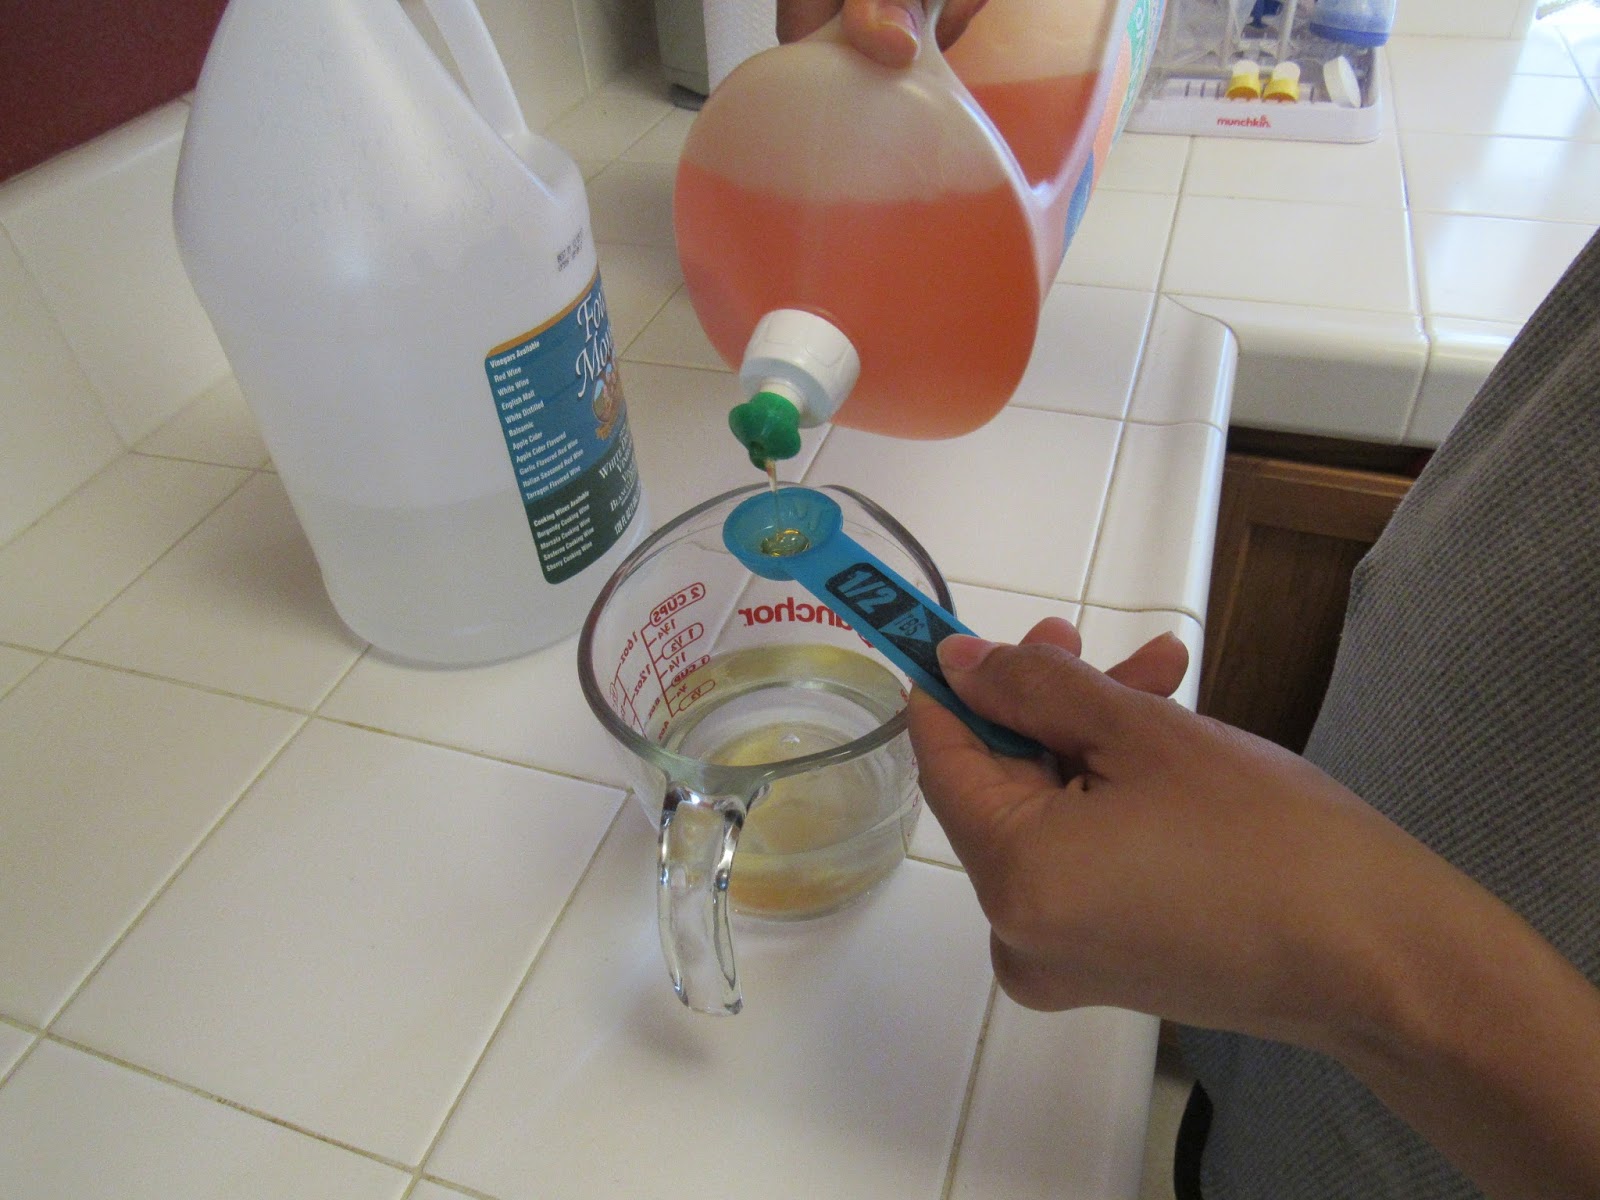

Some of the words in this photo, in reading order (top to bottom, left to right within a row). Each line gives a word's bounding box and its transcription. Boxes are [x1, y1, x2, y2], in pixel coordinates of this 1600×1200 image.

[489, 352, 516, 369] Vinegars
[516, 340, 541, 359] Available
[493, 371, 507, 383] Red
[506, 366, 522, 378] Wine
[497, 384, 515, 397] White
[515, 378, 530, 389] Wine
[501, 397, 523, 411] English
[504, 412, 522, 424] White
[522, 400, 545, 417] Distilled
[508, 421, 534, 437] Balsamic
[512, 438, 529, 451] Apple
[528, 431, 543, 443] Cider
[516, 451, 532, 463] Apple
[531, 444, 546, 456] Cider
[546, 431, 567, 449] Flavored
[519, 463, 536, 475] Garlic
[536, 452, 558, 468] Flavored
[557, 445, 568, 457] Red
[567, 438, 579, 450] Wine
[522, 475, 541, 488] Italian
[540, 461, 564, 480] Seasoned
[563, 455, 574, 467] Red
[573, 448, 585, 461] Wine
[549, 472, 571, 490] Flavored
[569, 465, 581, 476] Wine
[533, 512, 556, 527] Cooking
[554, 504, 571, 517] Wines
[569, 489, 590, 508] Available
[560, 511, 580, 527] Cooking
[578, 503, 590, 515] Wine
[560, 524, 580, 540] Cooking
[579, 516, 591, 528] Wine
[564, 534, 584, 550] Cooking
[583, 526, 595, 538] Wine
[546, 559, 564, 572] Sherry
[563, 549, 583, 564] Cooking
[580, 540, 593, 552] Wine
[837, 569, 898, 615] 1/2
